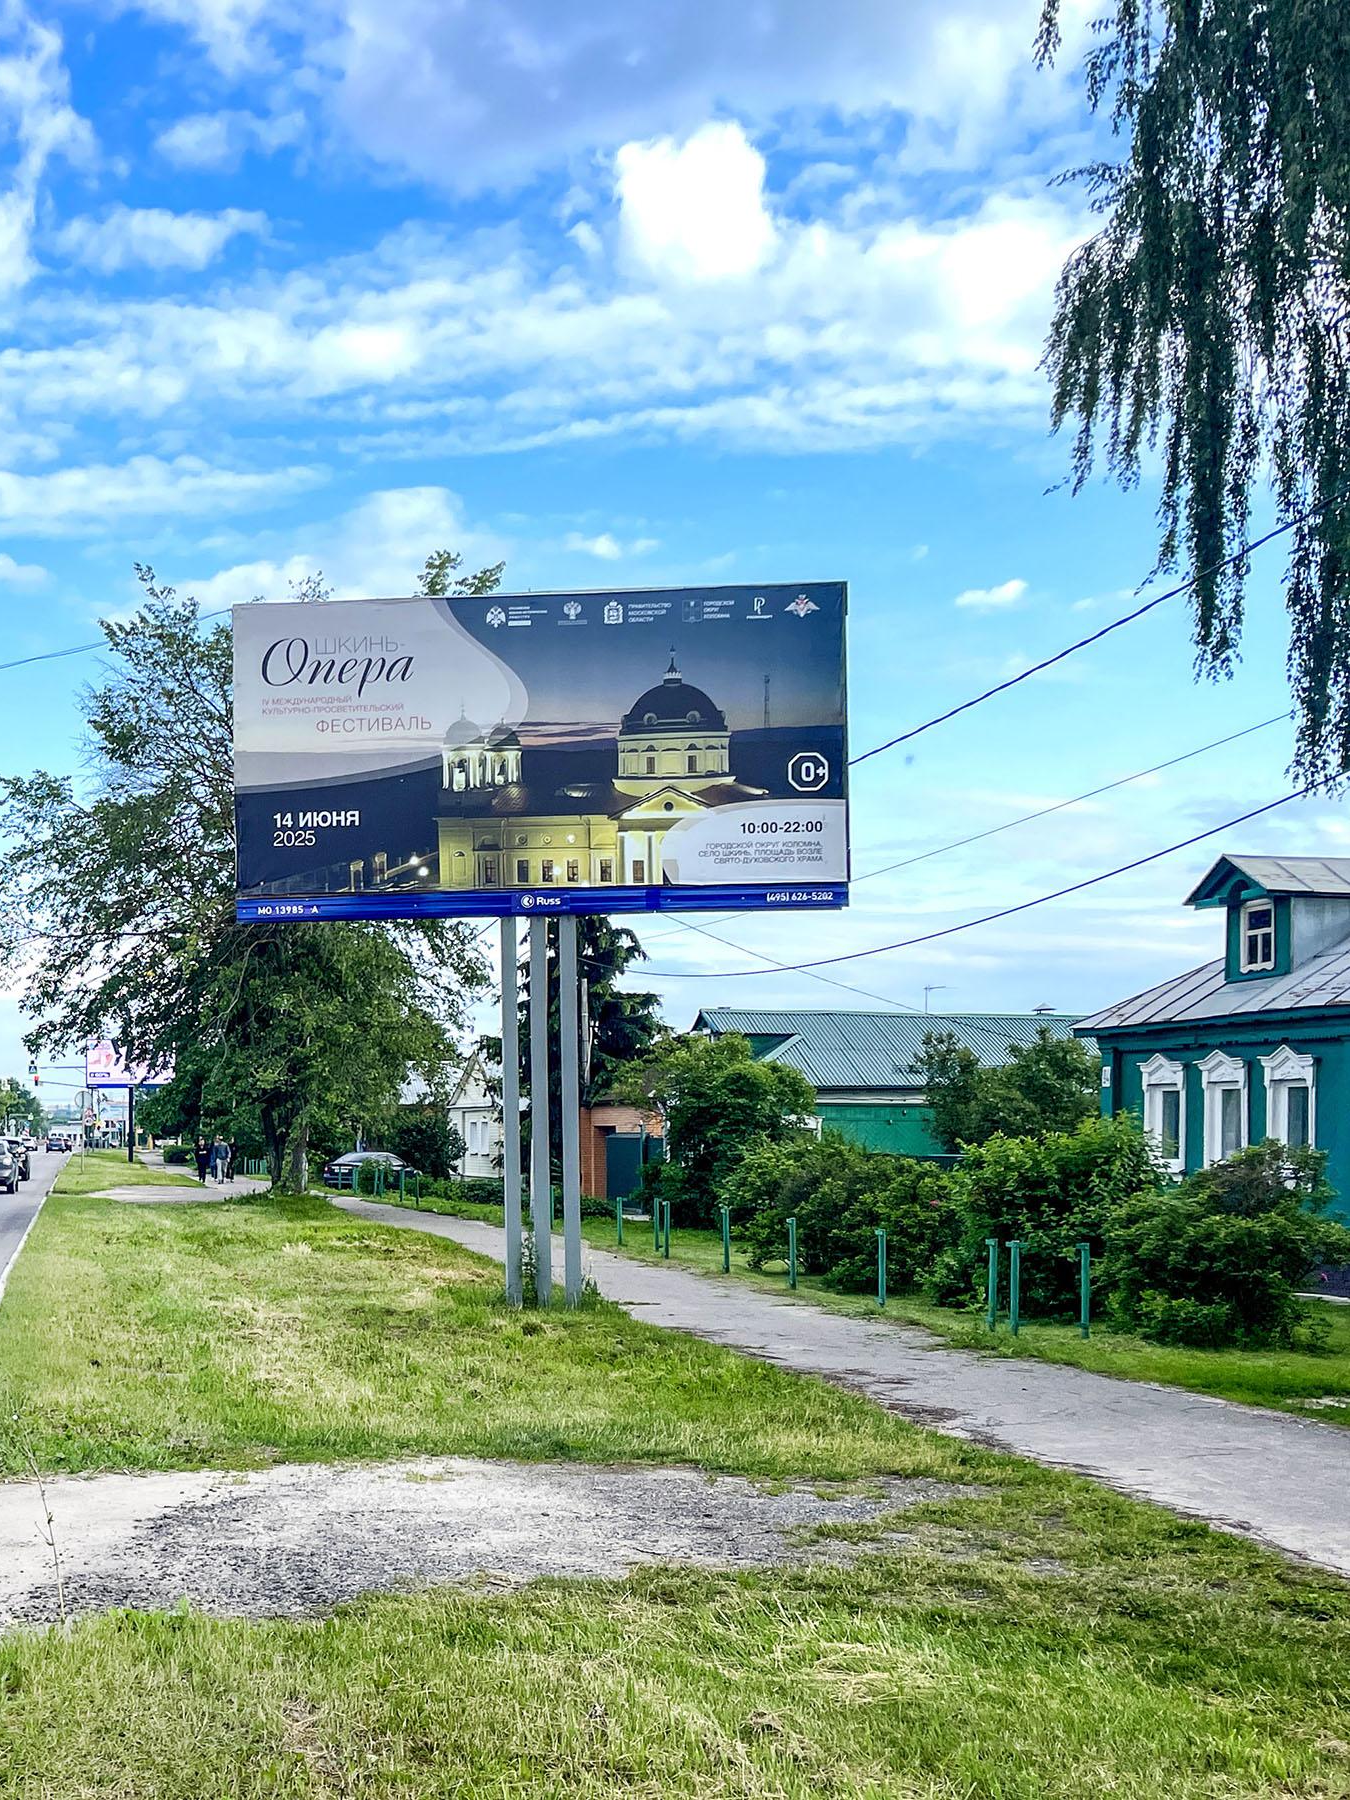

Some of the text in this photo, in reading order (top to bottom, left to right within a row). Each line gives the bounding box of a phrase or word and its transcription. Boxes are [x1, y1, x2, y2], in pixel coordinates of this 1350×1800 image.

[314, 635, 406, 655] ШКИНЬ-
[261, 637, 415, 699] Опера
[271, 695, 353, 706] МЕЖДУНАРОДНЫЙ
[261, 702, 405, 715] КУЛЬТУРНО-ПРОСВЕТИТЕЛЬСКИЙ
[315, 715, 433, 734] ФЕСТИВАЛЬ
[801, 761, 826, 782] 0+
[273, 810, 360, 828] 14 ИЮНЯ
[740, 820, 823, 834] 10:00-22:00
[273, 830, 316, 847] 2025
[705, 841, 753, 850] ГОРОДСКОЙ
[755, 841, 780, 849] ОКРУГ
[754, 848, 795, 856] ПЛОЩАДЬ
[796, 847, 823, 855] ВОЗЛЕ
[714, 856, 795, 865] СВЯТО-ДУХОВСКОГО
[536, 896, 561, 906] Russ
[767, 892, 833, 902] (495) 626-5202
[257, 906, 272, 915] МО
[275, 905, 304, 915] 13985
